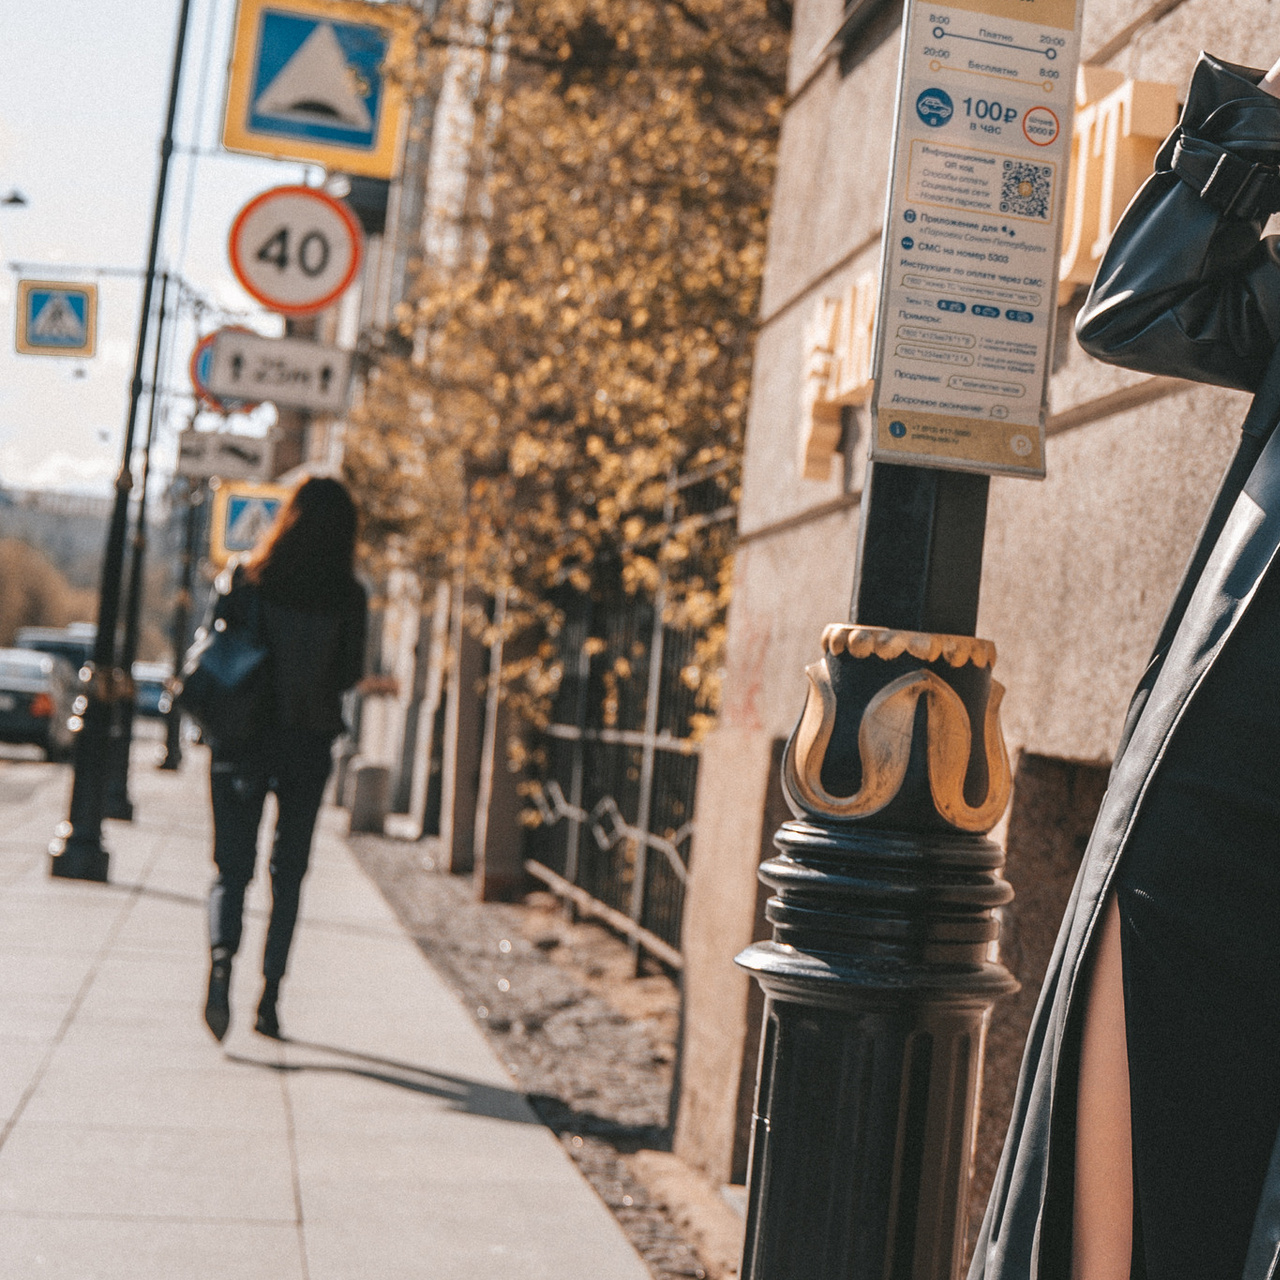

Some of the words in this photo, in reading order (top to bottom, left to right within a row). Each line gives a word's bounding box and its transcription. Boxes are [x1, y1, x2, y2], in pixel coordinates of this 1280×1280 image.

[929, 14, 950, 25] 8:00
[979, 28, 1014, 42] Платно
[1039, 34, 1066, 47] 20:00
[923, 47, 950, 59] 20:00
[968, 60, 1018, 77] Бесплатно
[1039, 68, 1060, 79] 8:00
[970, 122, 977, 131] в
[980, 125, 1002, 135] час
[920, 213, 980, 230] Приложение
[981, 224, 998, 234] для
[257, 226, 330, 278] 40
[918, 242, 941, 253] СМС
[943, 247, 954, 256] на
[956, 249, 986, 261] номер
[900, 259, 951, 273] Инструкция
